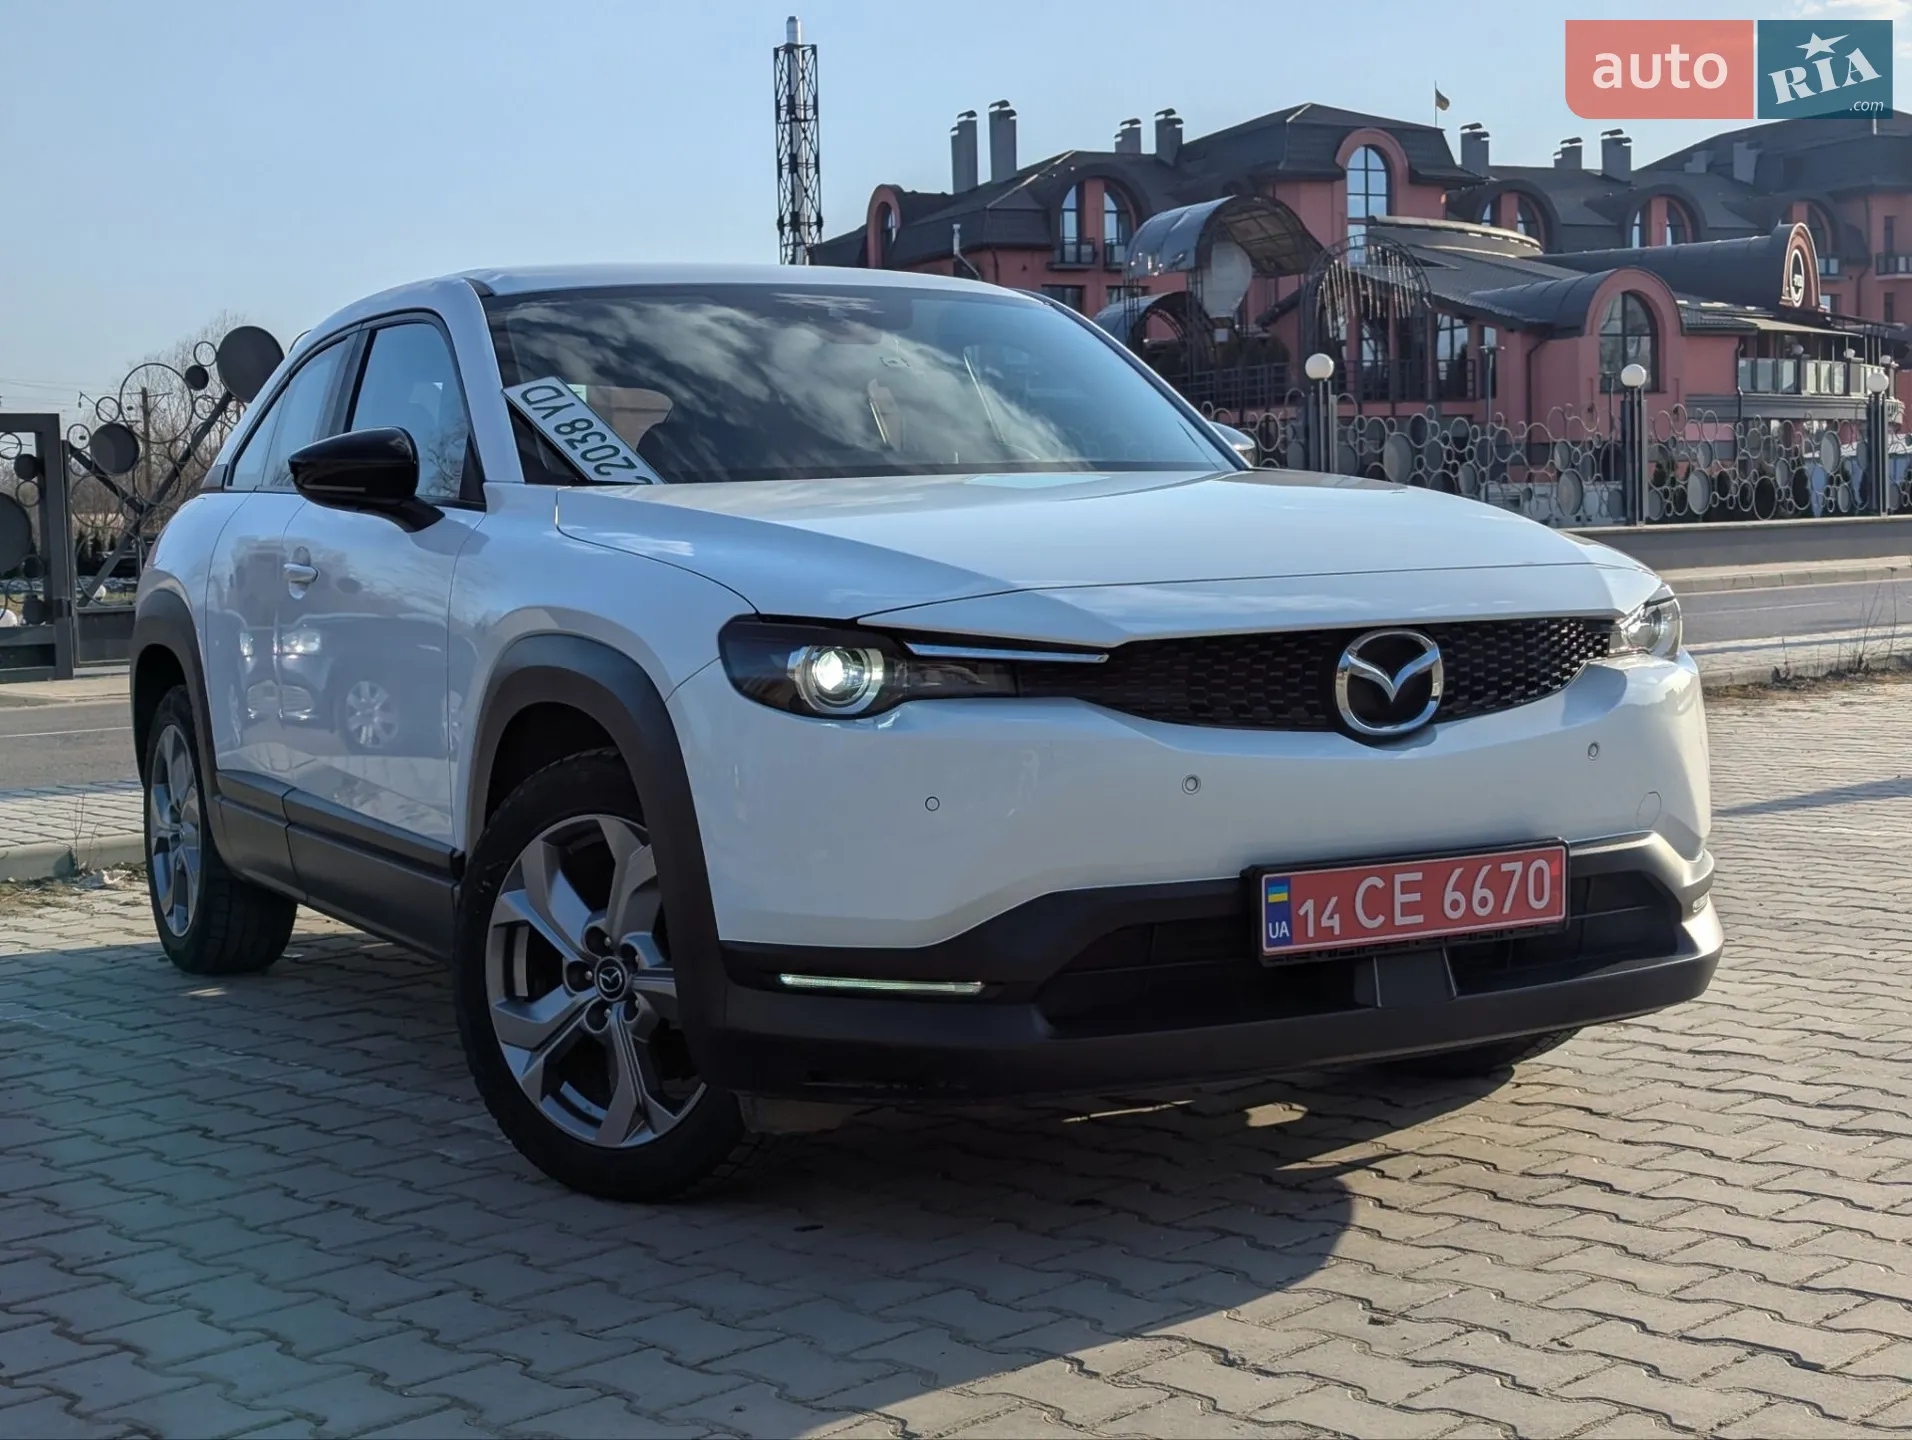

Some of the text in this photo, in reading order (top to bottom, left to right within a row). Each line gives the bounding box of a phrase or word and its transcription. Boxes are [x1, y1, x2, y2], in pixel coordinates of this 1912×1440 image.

[520, 385, 638, 476] 2038 YD
[1268, 920, 1290, 939] UA
[1298, 858, 1551, 938] 14 CE 6670
